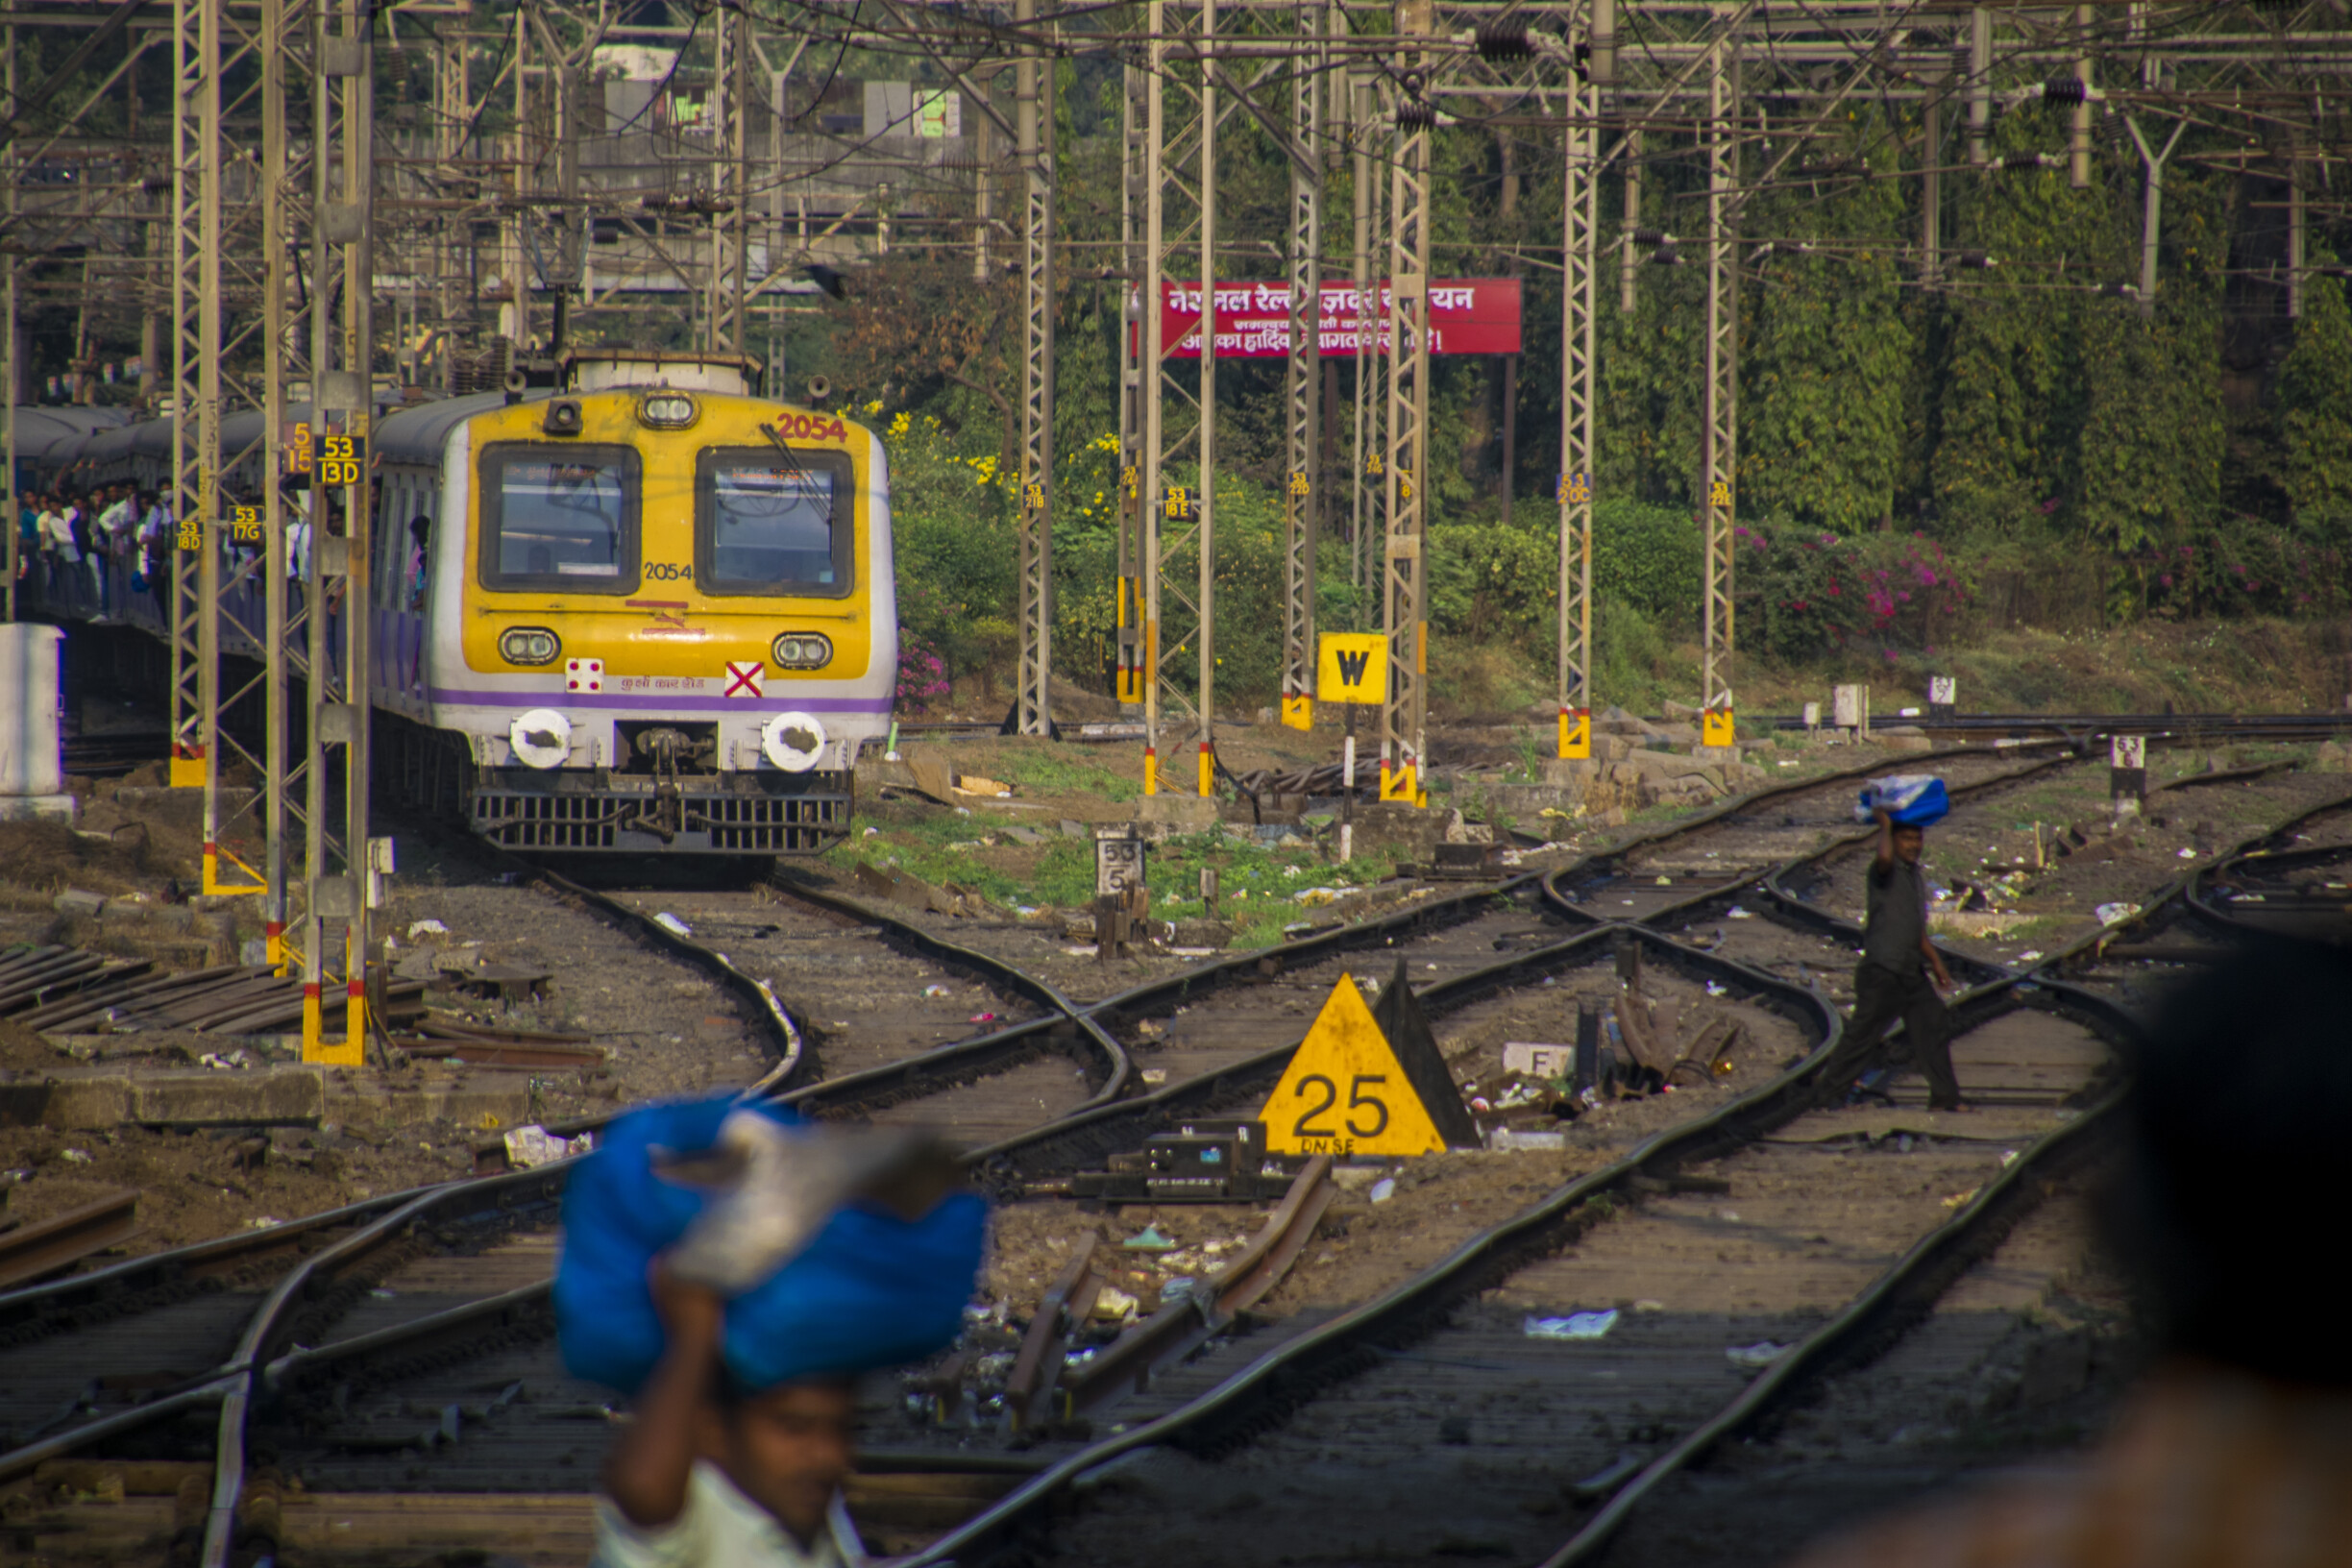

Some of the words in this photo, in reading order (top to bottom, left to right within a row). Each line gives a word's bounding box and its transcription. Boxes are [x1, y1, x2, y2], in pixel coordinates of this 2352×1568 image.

[777, 413, 847, 443] 2054
[325, 437, 355, 458] 53
[321, 462, 358, 483] 13D
[1292, 473, 1307, 482] 53
[1562, 474, 1584, 488] 53
[1714, 482, 1728, 493] 53
[1027, 485, 1041, 496] 53
[1167, 488, 1186, 501] 53
[1557, 487, 1590, 504] 20C
[1025, 497, 1044, 508] 21B
[235, 508, 257, 522] 53
[180, 522, 198, 534] 53
[233, 526, 260, 540] 17G
[178, 536, 201, 550] 18D
[645, 561, 693, 580] 2054
[1336, 649, 1370, 686] W
[2118, 737, 2139, 752] 53
[1105, 844, 1136, 862] 53
[1110, 870, 1125, 890] 5
[1532, 1051, 1550, 1073] F
[1293, 1074, 1389, 1139] 25
